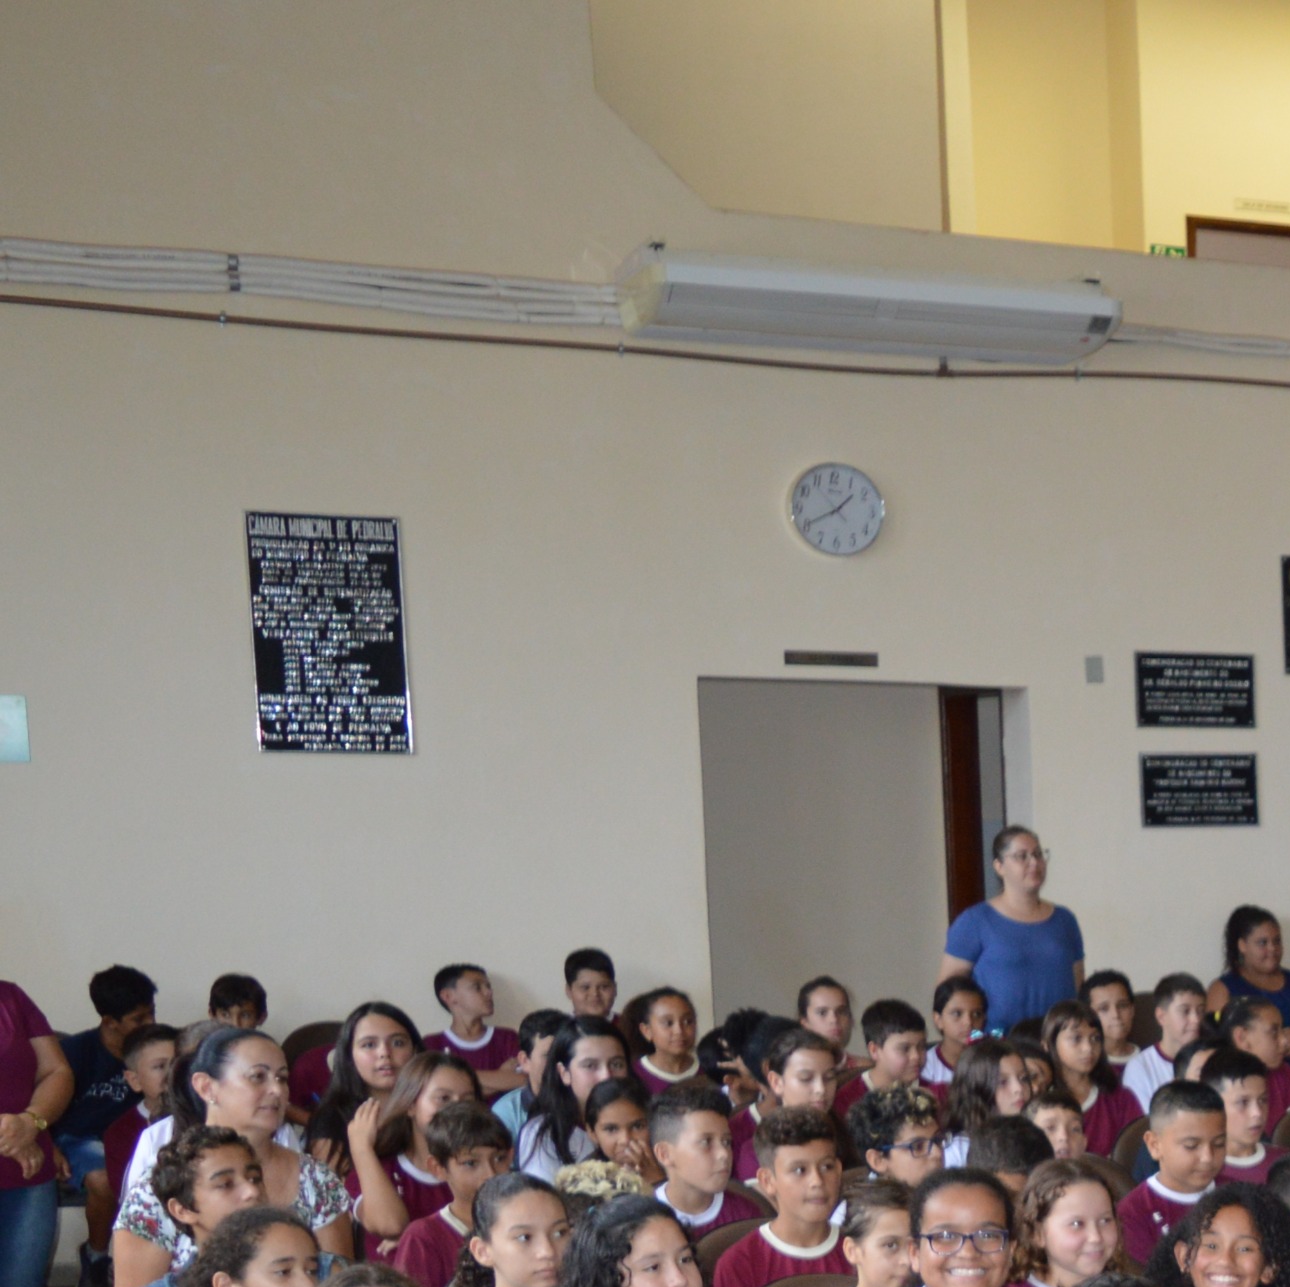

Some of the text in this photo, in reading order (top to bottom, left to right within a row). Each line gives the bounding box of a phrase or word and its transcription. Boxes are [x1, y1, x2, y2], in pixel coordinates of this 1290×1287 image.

[248, 515, 286, 536] CÂMARA
[288, 517, 335, 538] MUNICIPAL
[336, 519, 349, 538] DE
